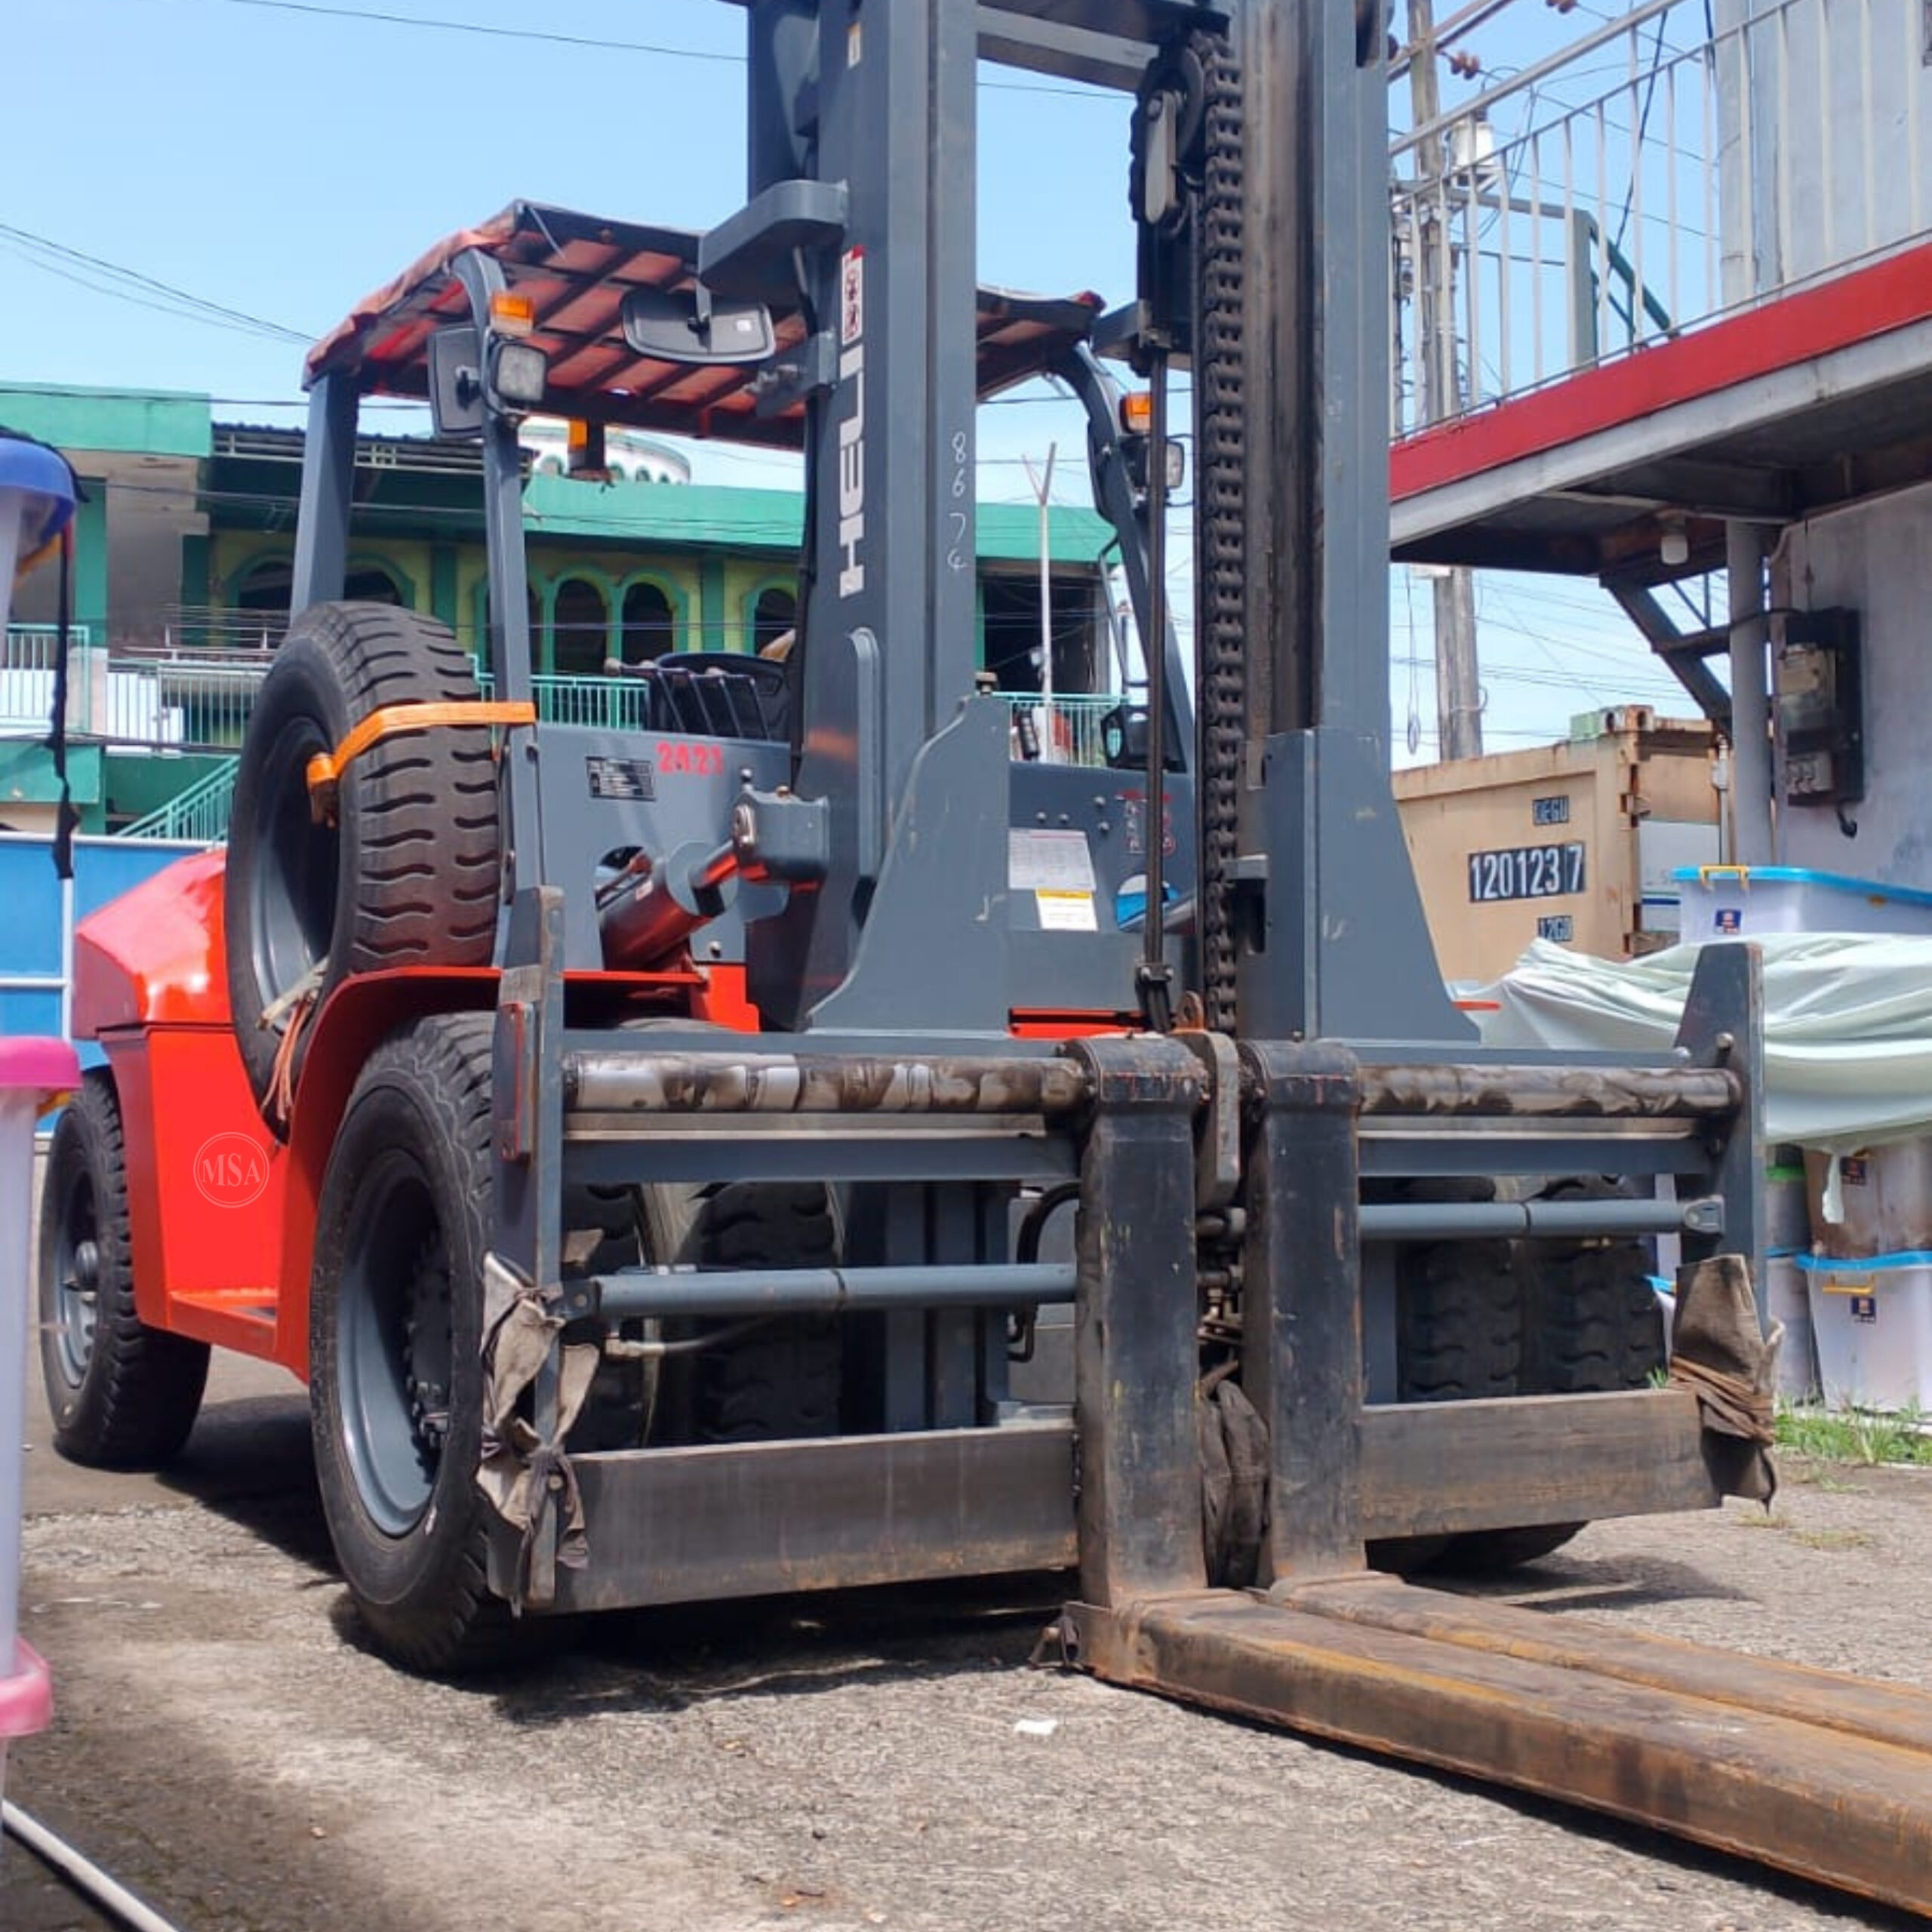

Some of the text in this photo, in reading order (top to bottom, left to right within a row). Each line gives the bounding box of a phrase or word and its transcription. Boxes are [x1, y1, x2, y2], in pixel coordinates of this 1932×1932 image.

[839, 343, 864, 598] HELI
[1472, 844, 1583, 900] 120123 7
